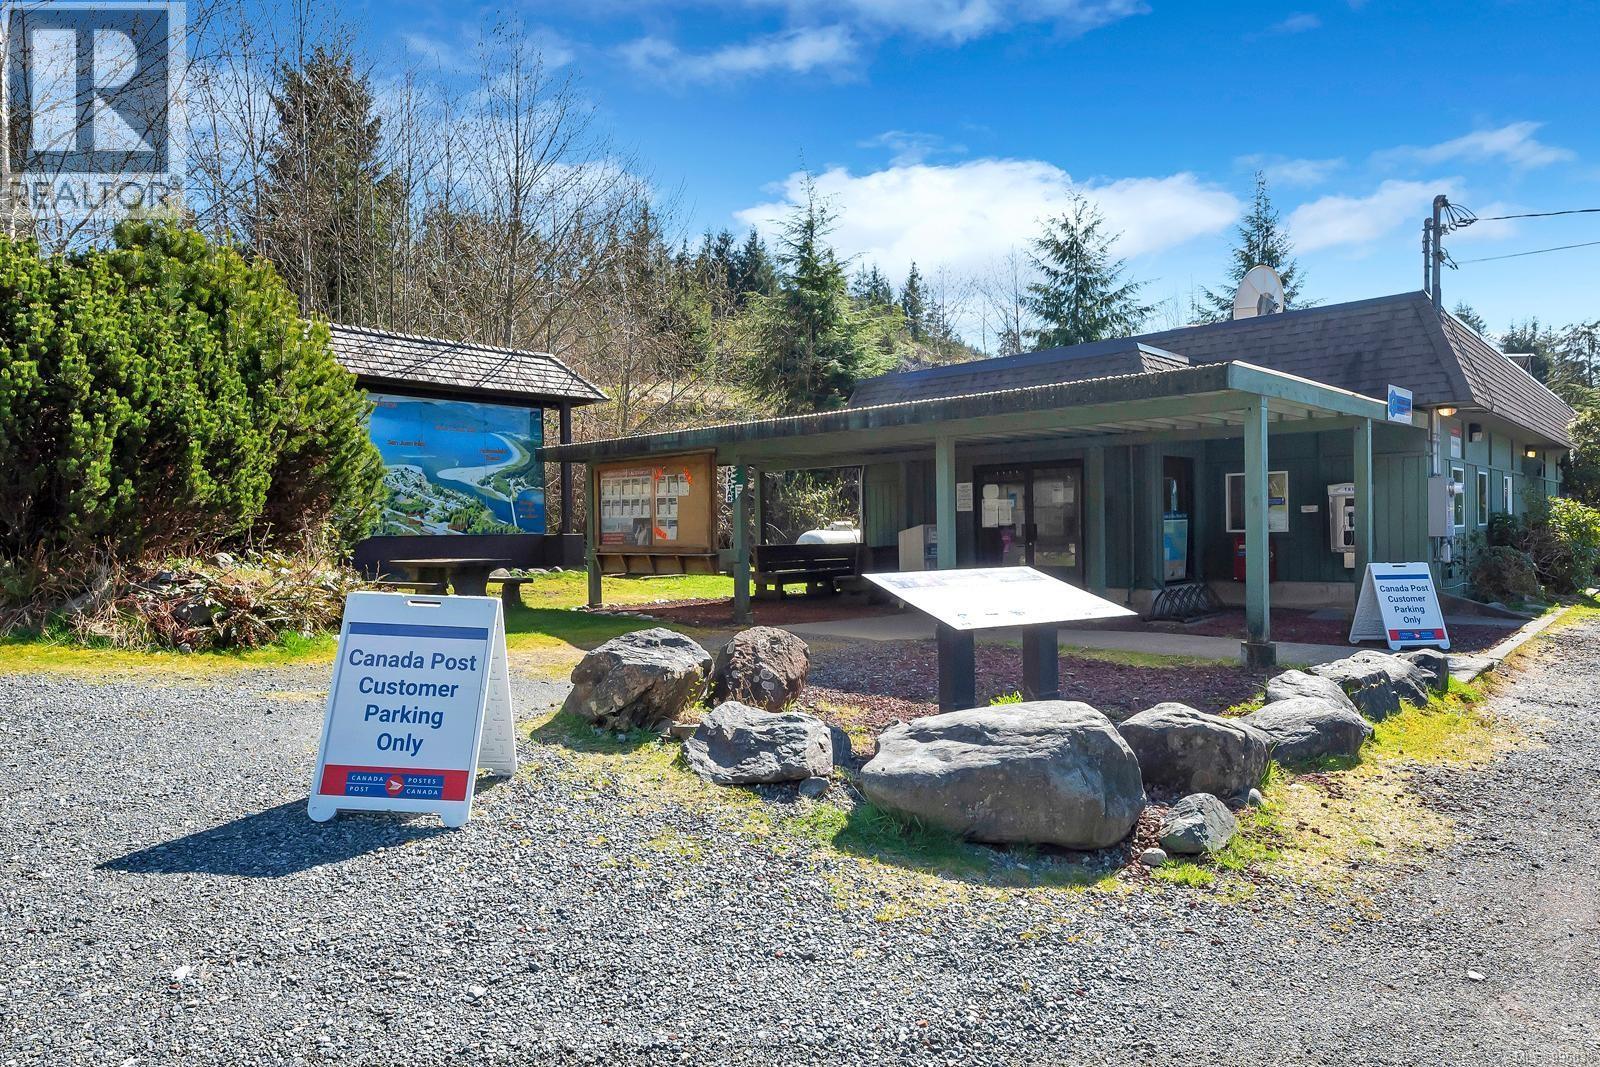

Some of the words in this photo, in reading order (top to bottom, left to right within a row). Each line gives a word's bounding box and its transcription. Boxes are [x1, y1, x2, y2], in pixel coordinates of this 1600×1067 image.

[1379, 584, 1409, 593] Canada
[1410, 584, 1430, 592] Post
[1387, 595, 1426, 603] Customer
[1394, 605, 1425, 614] Parking
[1403, 616, 1421, 625] Only
[349, 649, 424, 670] Canada
[430, 652, 477, 671] Post
[359, 676, 459, 698] Customer
[364, 704, 444, 729] Parking
[376, 732, 424, 757] Only
[351, 774, 384, 782] CANADA
